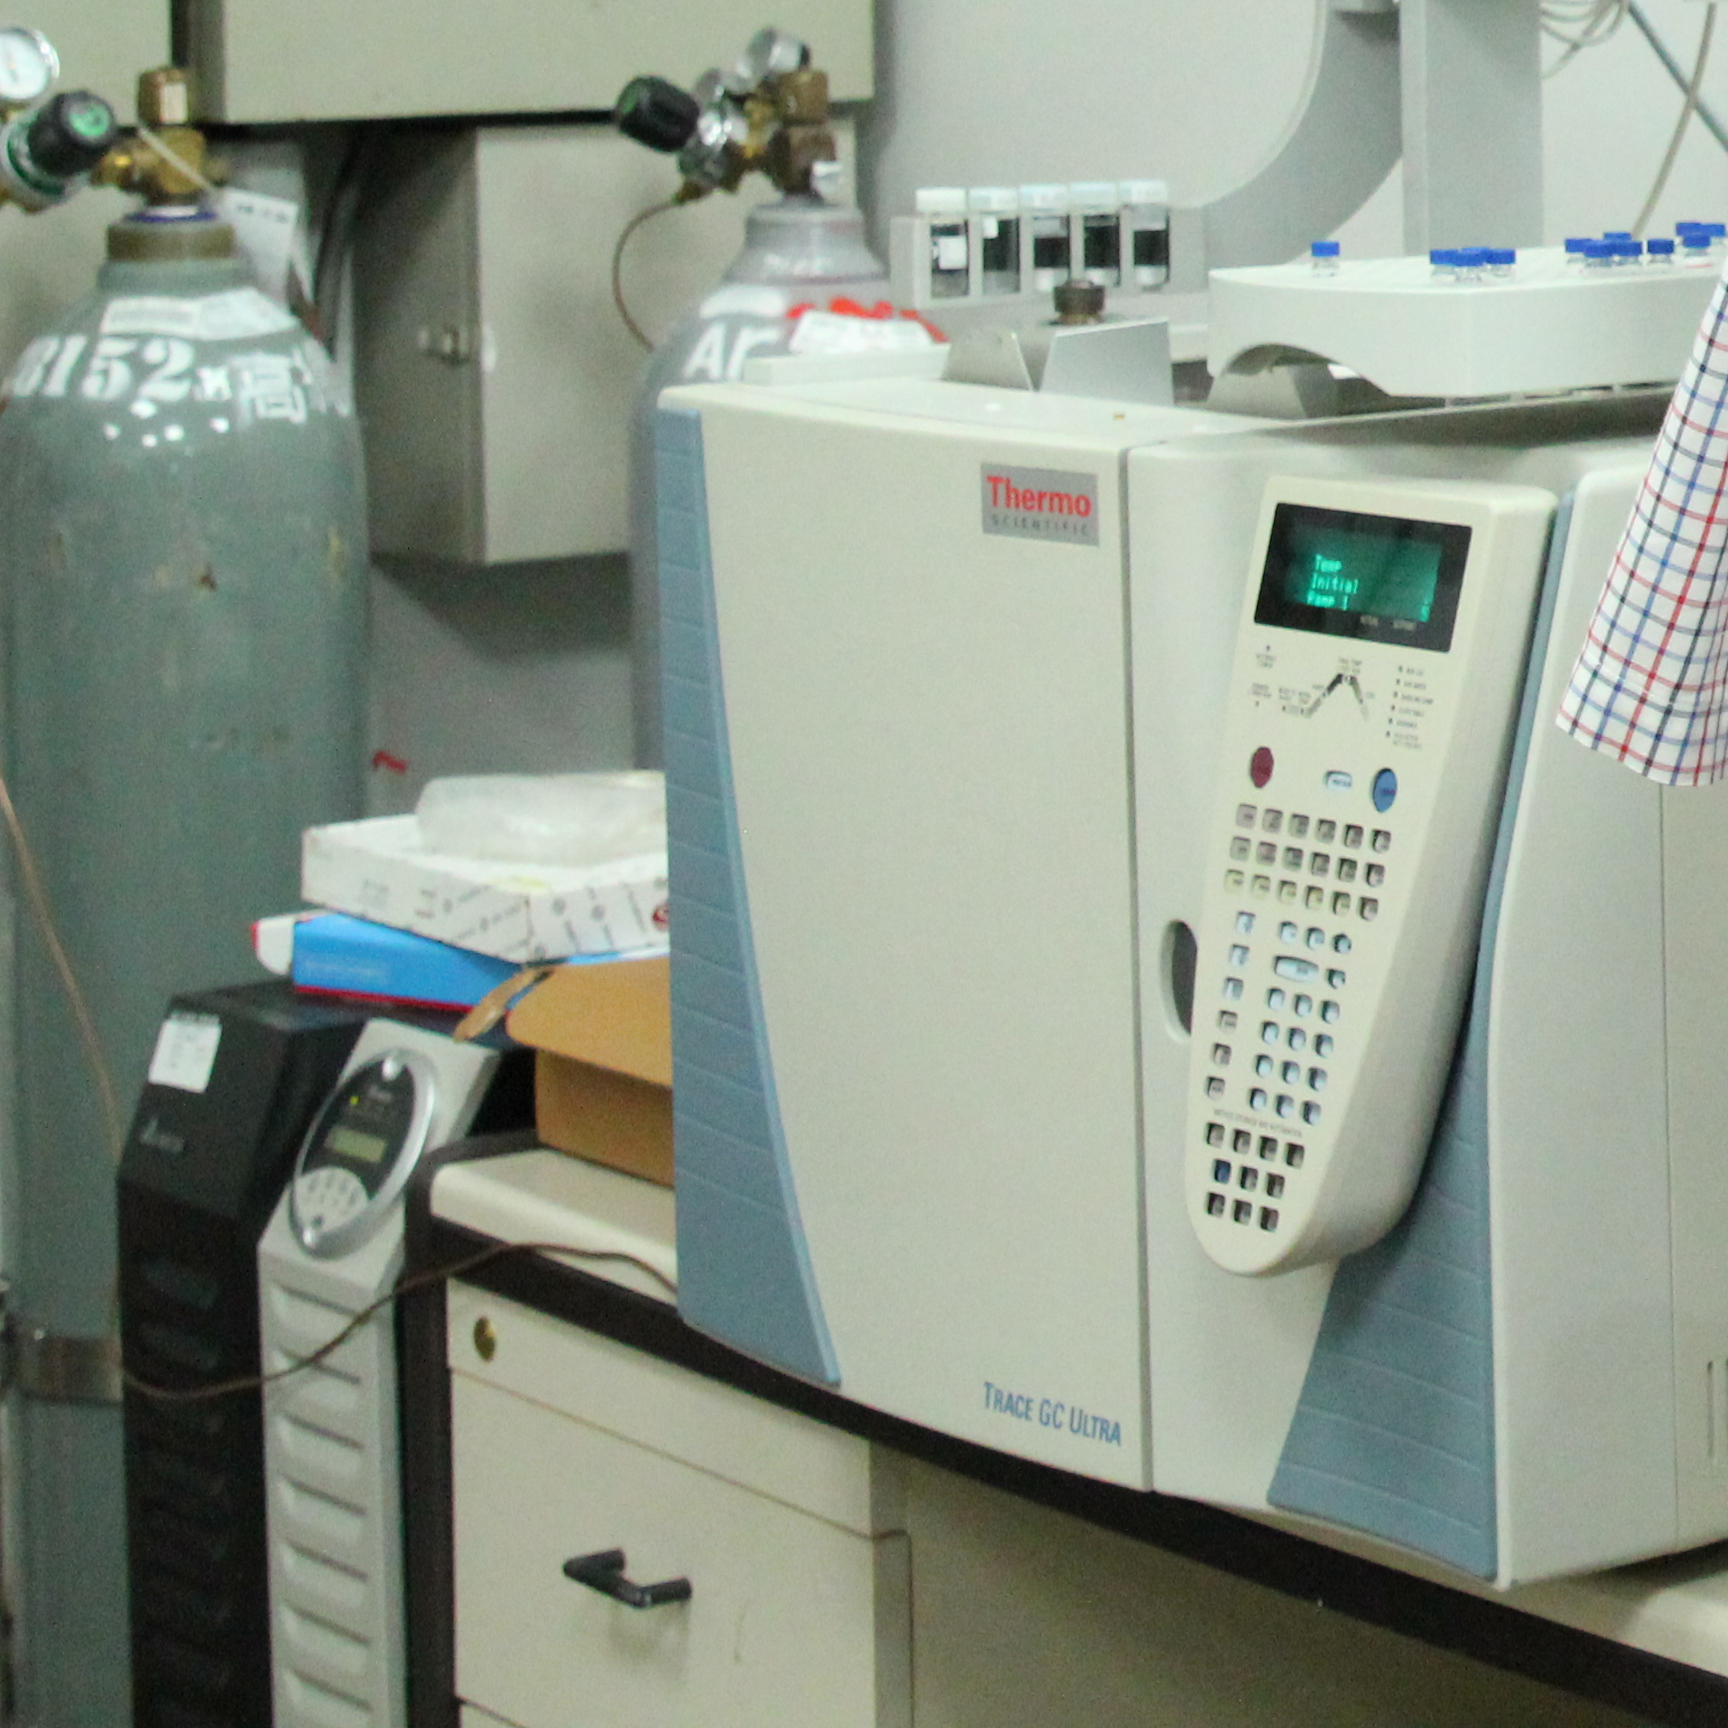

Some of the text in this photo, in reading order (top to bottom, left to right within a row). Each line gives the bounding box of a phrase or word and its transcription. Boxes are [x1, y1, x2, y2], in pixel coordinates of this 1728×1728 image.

[986, 475, 1092, 517] Thermo
[991, 514, 1088, 535] SCIENTIFIC
[1311, 572, 1358, 594] Initial
[984, 1381, 1122, 1447] TRACE GC ULTRA
